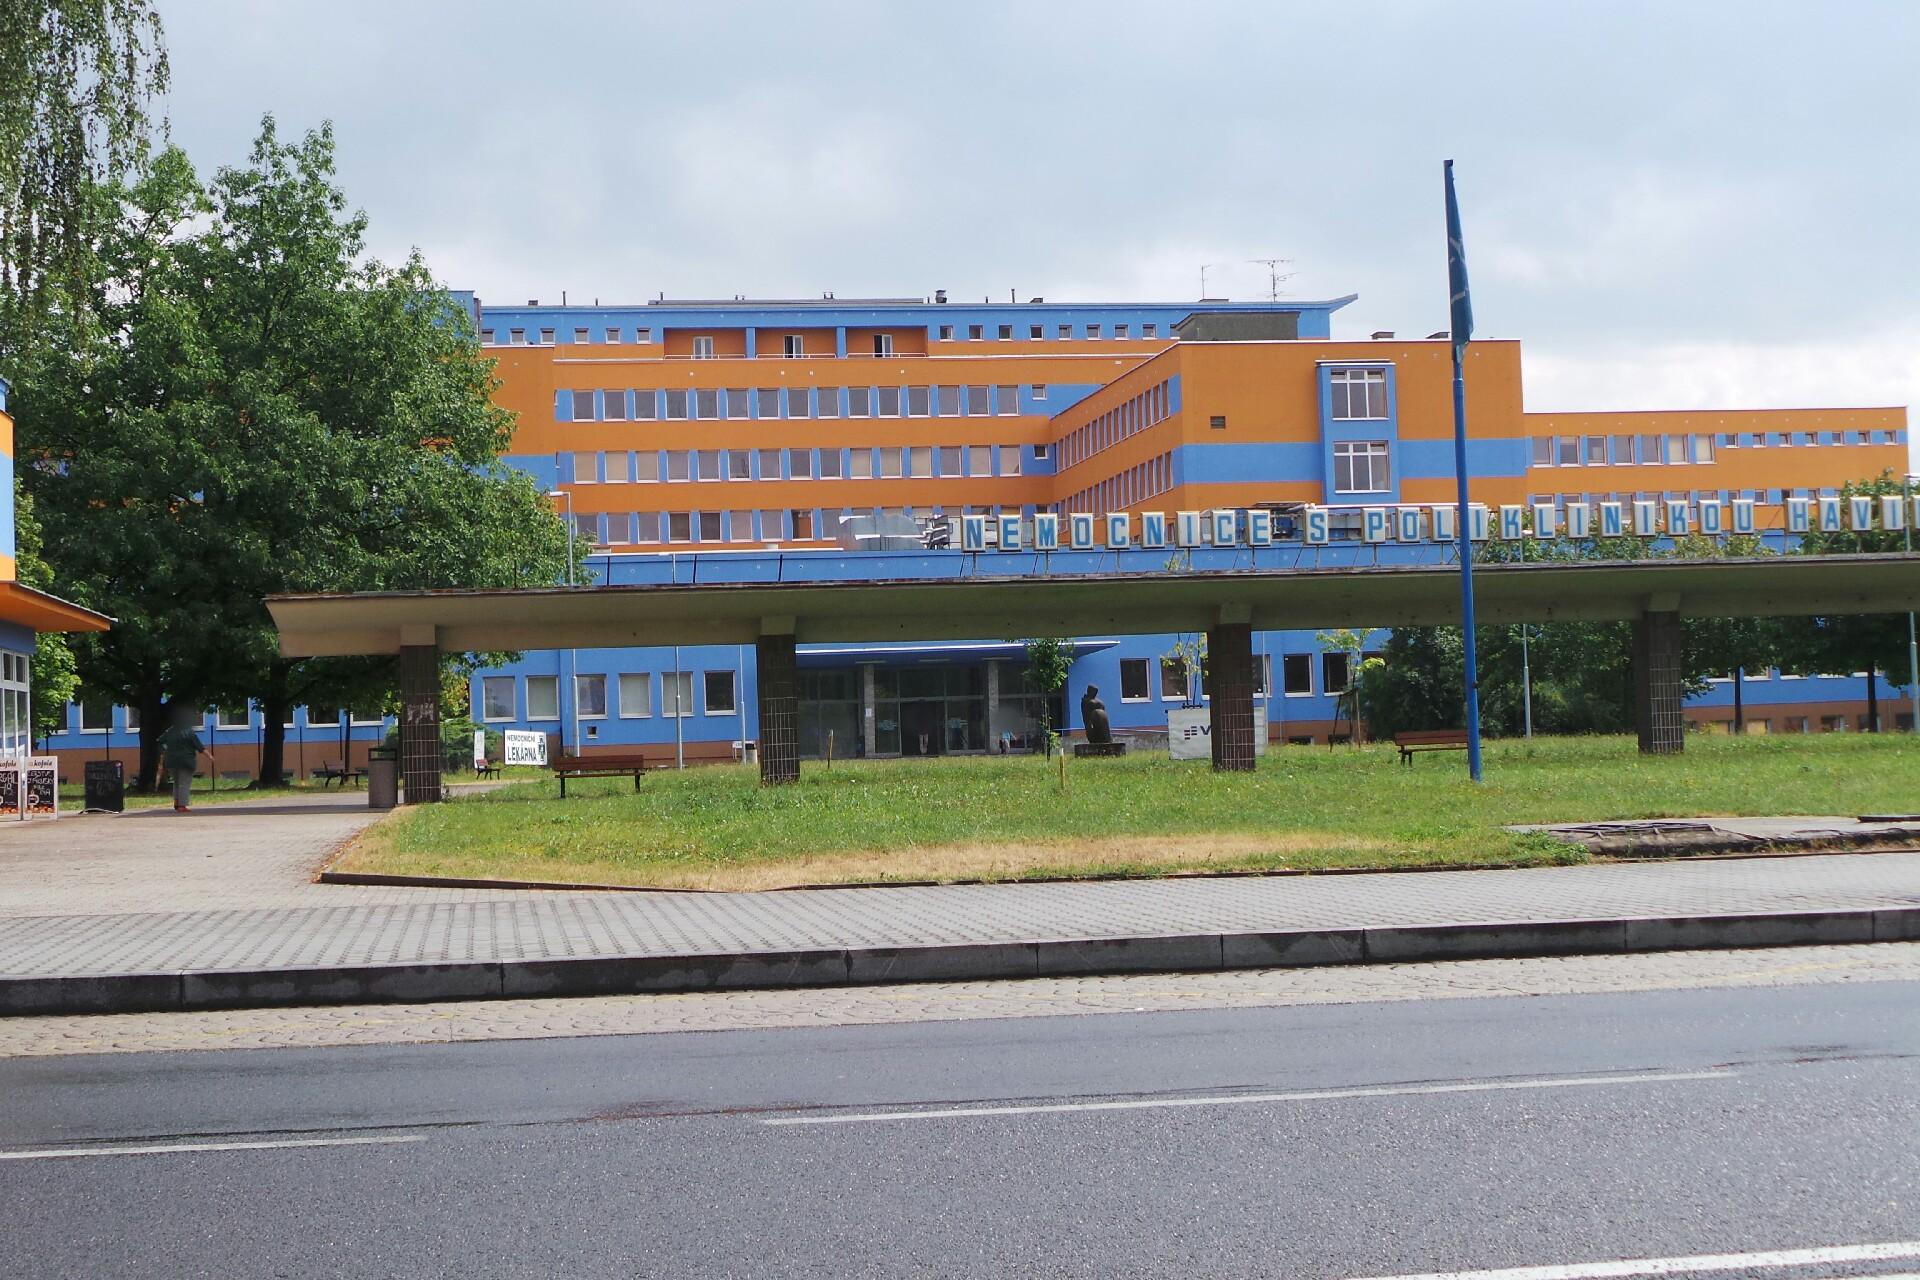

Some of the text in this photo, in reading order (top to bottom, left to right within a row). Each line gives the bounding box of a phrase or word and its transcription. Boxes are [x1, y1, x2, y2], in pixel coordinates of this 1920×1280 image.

[965, 512, 1269, 549] NEMOCNICE
[1308, 511, 1326, 543] S
[1367, 503, 1752, 540] POLIKLINIKOU
[507, 743, 537, 761] LÉKÁRNA
